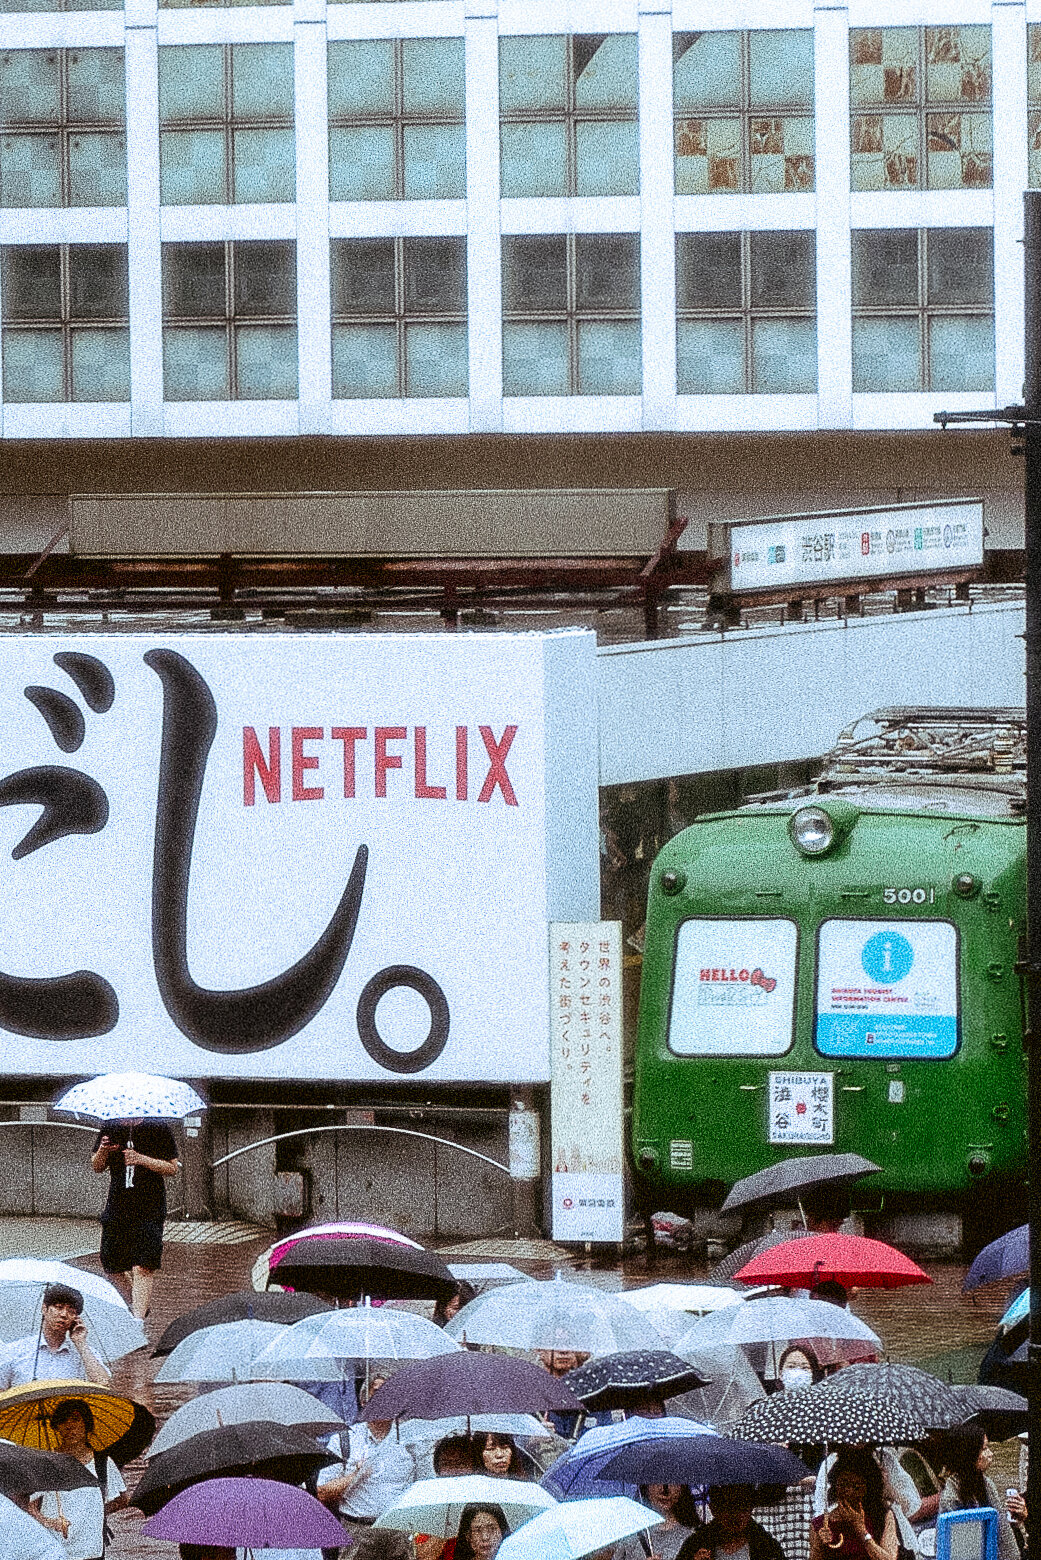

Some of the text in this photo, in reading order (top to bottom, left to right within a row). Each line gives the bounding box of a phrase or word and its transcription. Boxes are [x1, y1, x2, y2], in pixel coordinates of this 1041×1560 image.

[242, 724, 519, 806] NETFLIX
[883, 888, 935, 904] 5001
[598, 940, 612, 1052] 世界の渋谷へ。
[699, 968, 750, 982] HELLO
[580, 940, 591, 1105] タウンセキュリティを
[774, 1076, 827, 1085] SHIBUYA
